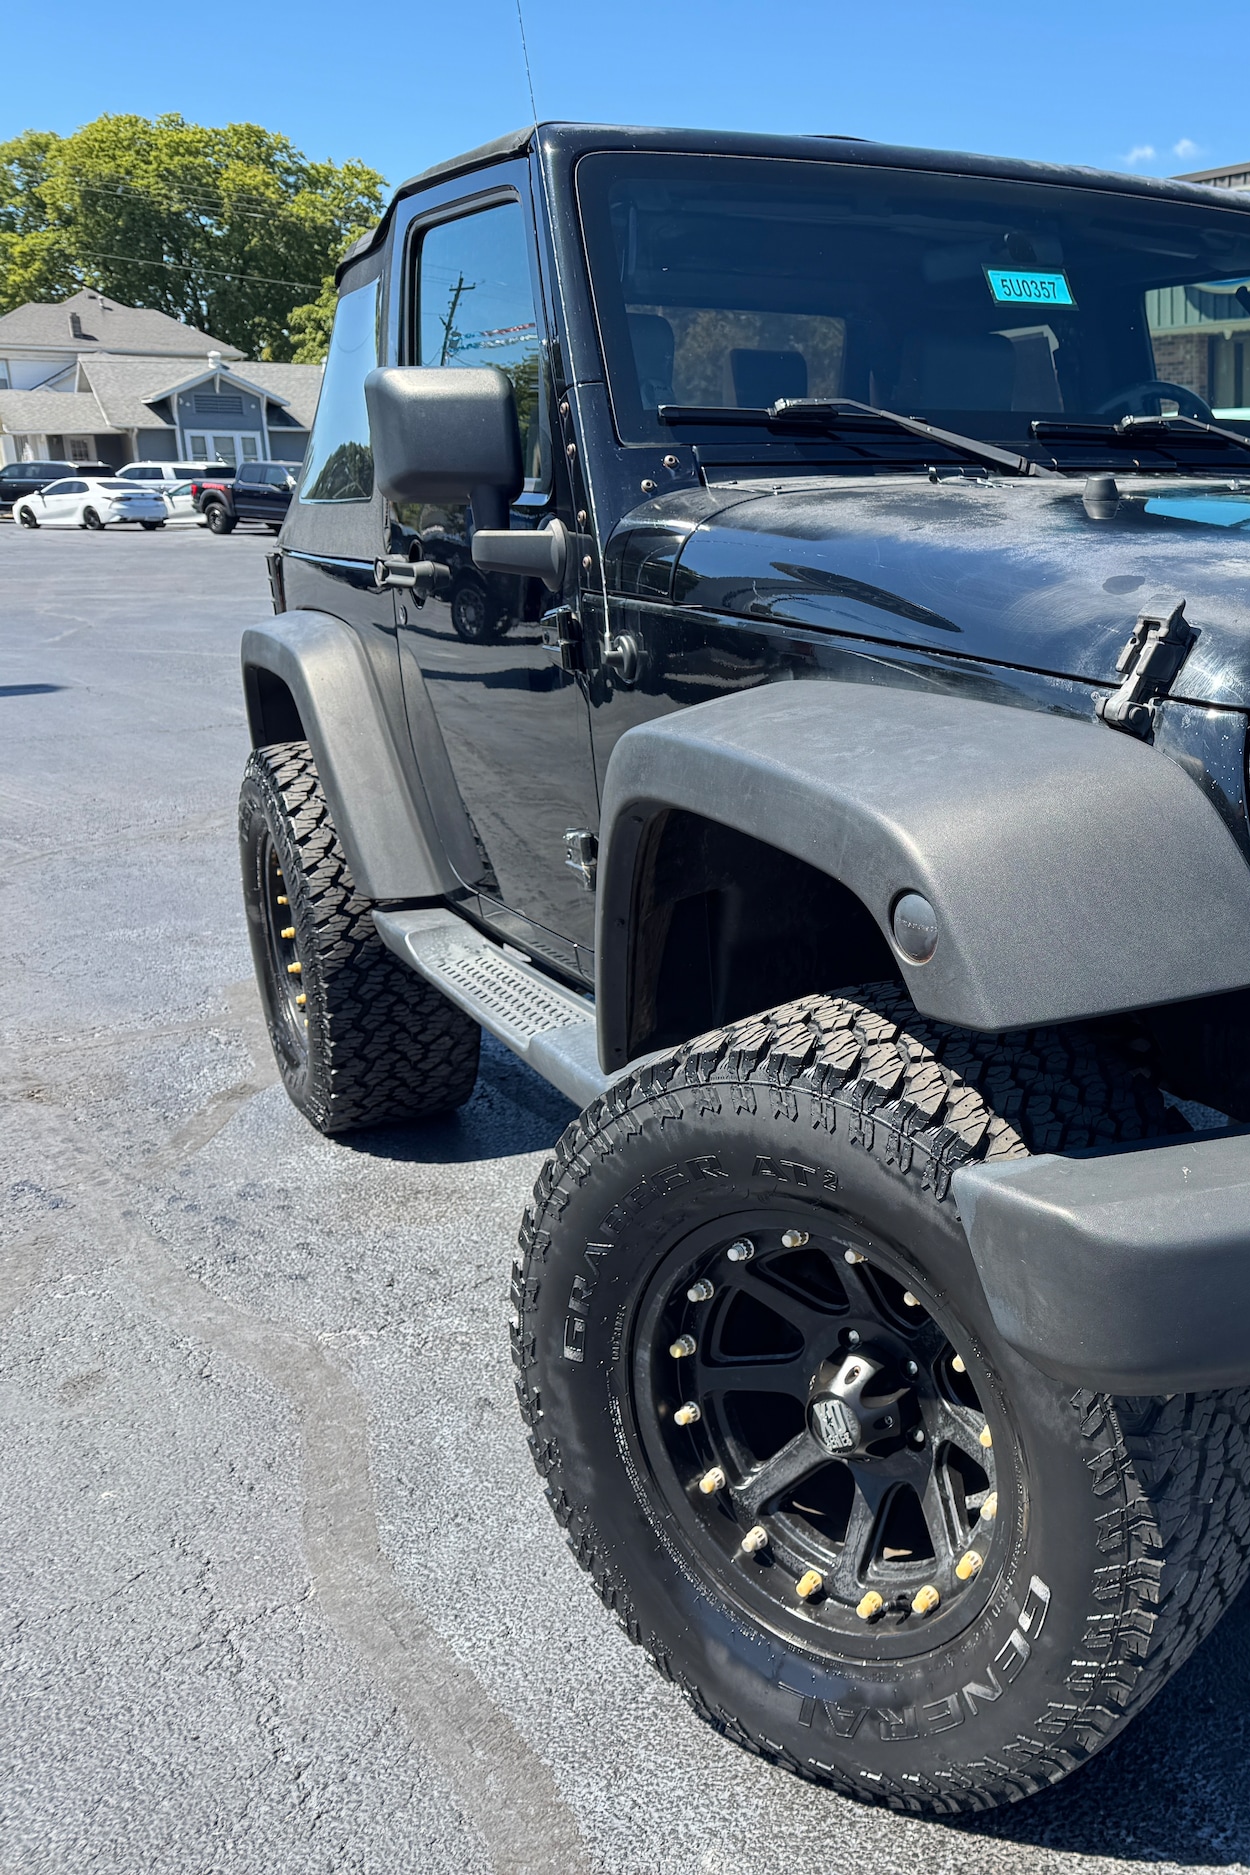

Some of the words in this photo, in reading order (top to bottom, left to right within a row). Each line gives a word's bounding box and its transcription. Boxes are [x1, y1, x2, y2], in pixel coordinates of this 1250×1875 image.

[1000, 278, 1057, 300] 5U0357
[563, 1155, 729, 1363] GRABBER
[778, 1574, 1052, 1742] GENERAL
